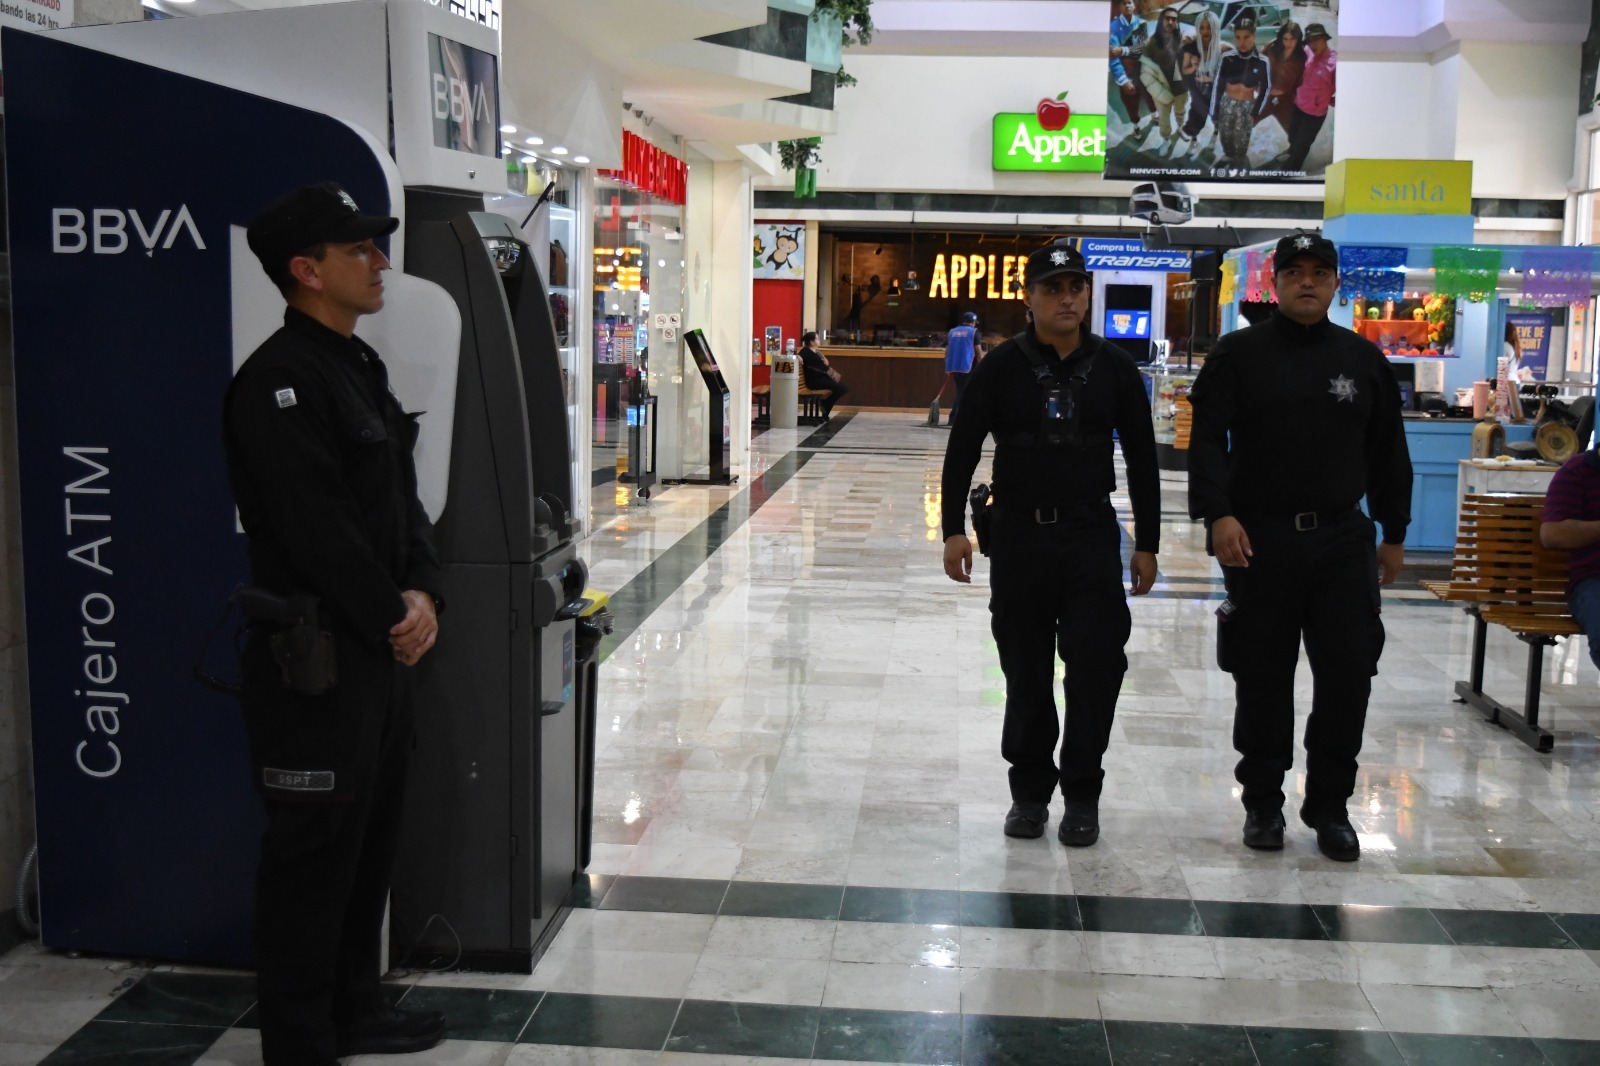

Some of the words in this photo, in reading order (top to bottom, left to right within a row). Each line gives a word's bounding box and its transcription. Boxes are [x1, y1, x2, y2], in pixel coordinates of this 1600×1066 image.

[25, 8, 36, 23] las
[37, 12, 47, 26] 24
[433, 72, 491, 126] BBVA
[1130, 167, 1201, 176] INNVICTUS.COM
[1249, 169, 1307, 177] INNVICTUSMX
[1369, 179, 1446, 203] santa
[52, 204, 206, 258] BBVA
[1088, 243, 1124, 252] Compra
[1126, 244, 1140, 252] tus
[63, 446, 113, 576] ATM
[73, 591, 131, 778] Cajero
[279, 774, 312, 786] SSPT
